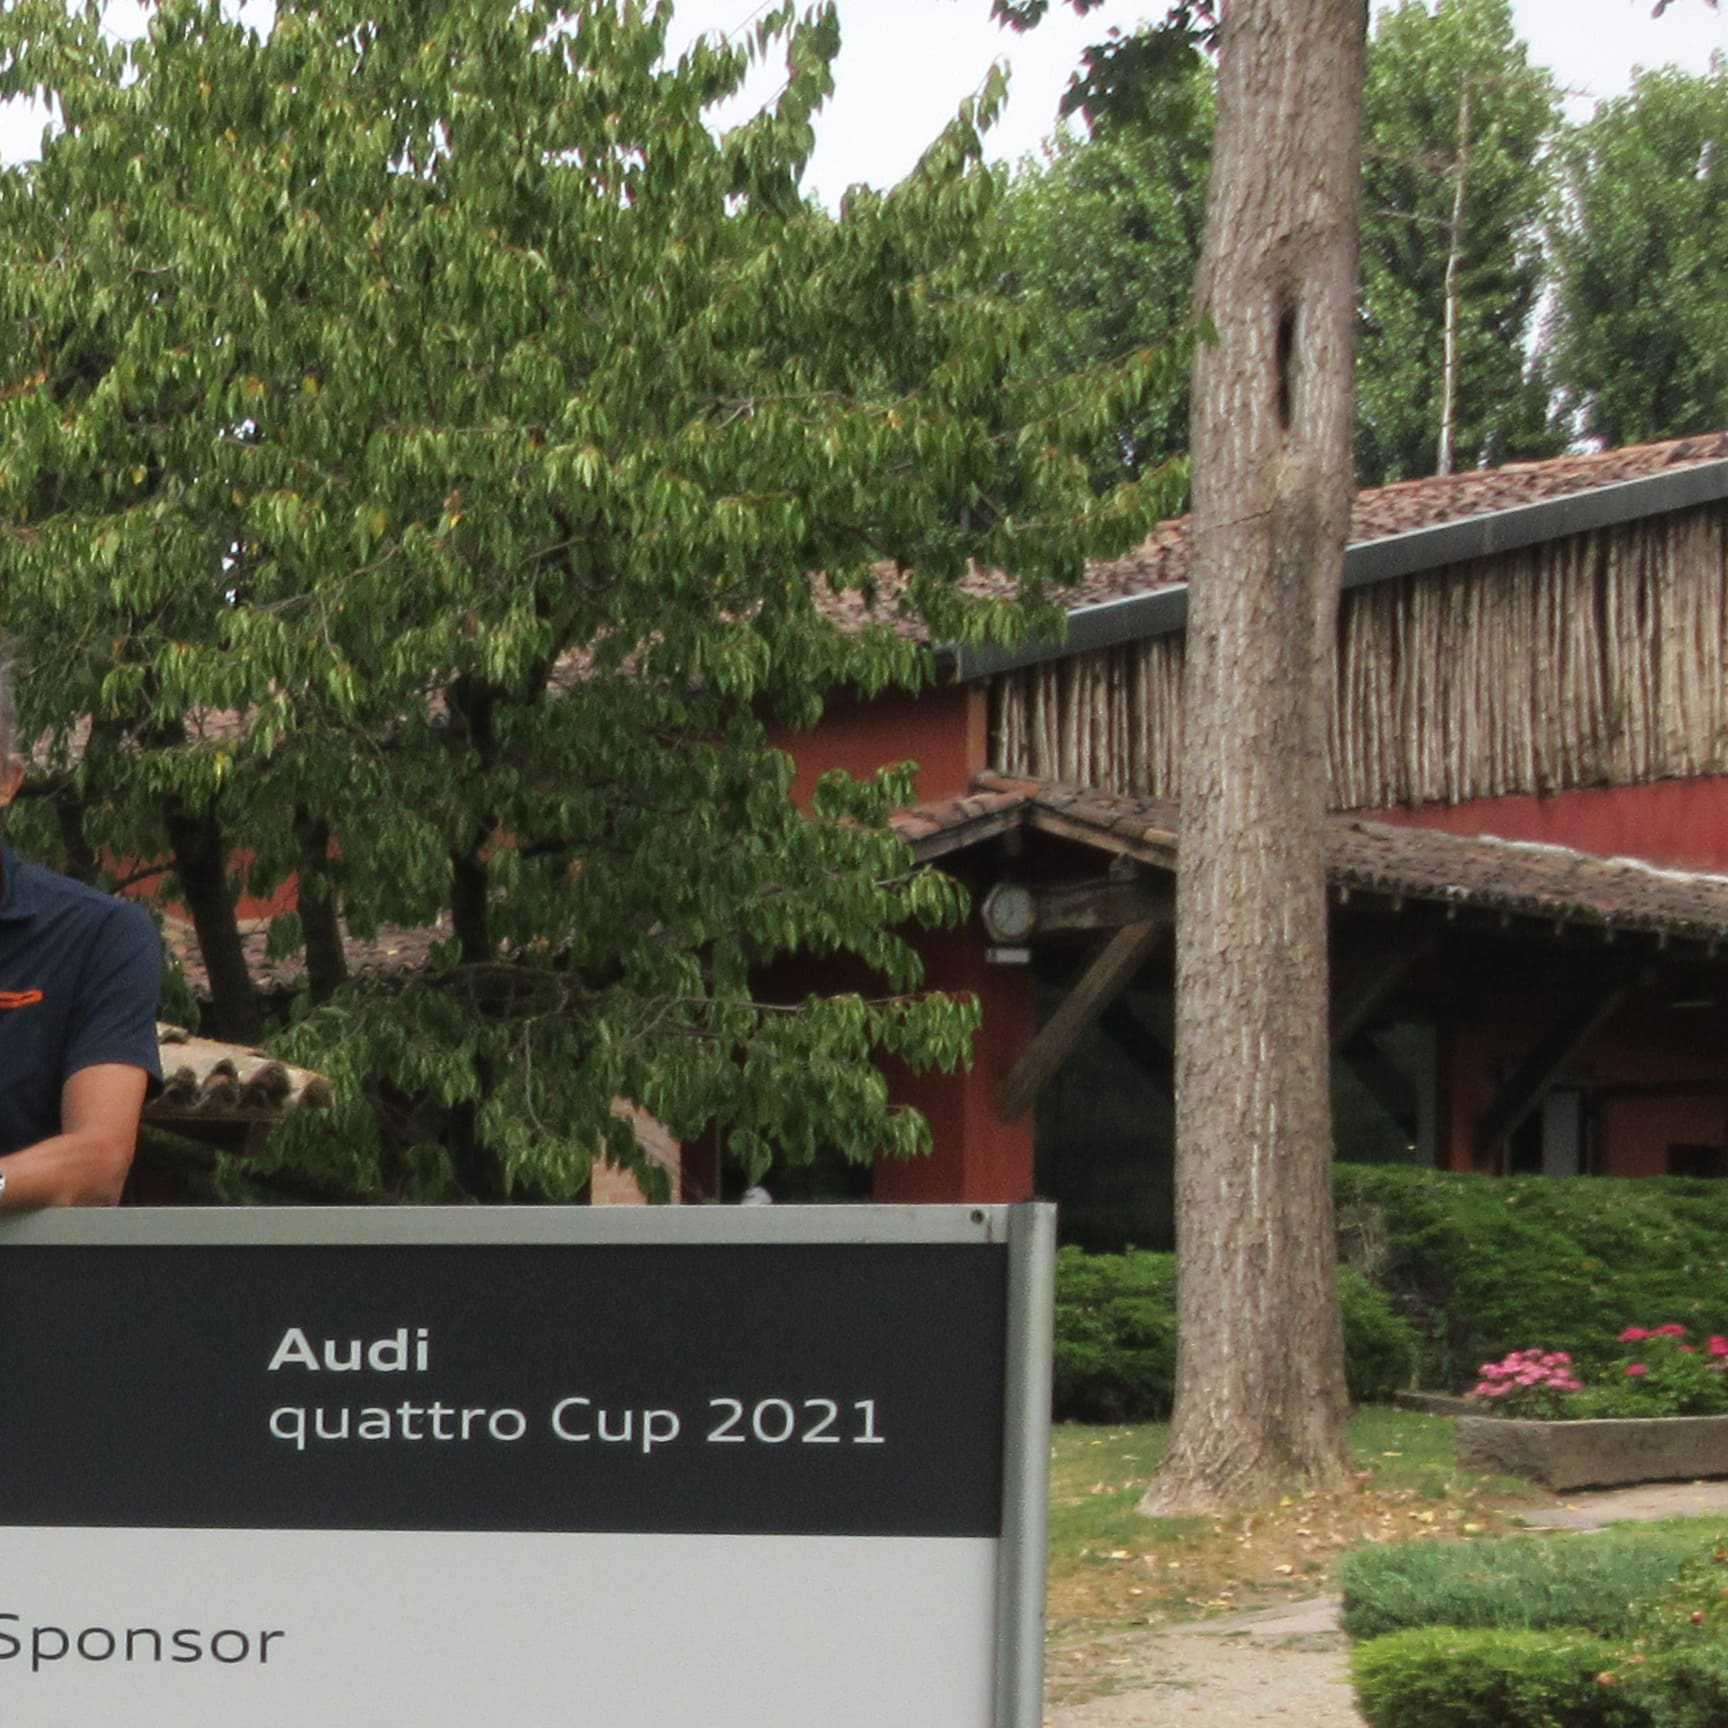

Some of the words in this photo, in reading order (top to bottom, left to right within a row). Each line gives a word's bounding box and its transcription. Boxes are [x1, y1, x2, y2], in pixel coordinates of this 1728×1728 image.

[267, 1328, 429, 1372] Audi
[269, 1400, 526, 1450] quattro
[552, 1397, 680, 1453] Cup
[707, 1398, 885, 1443] 2021
